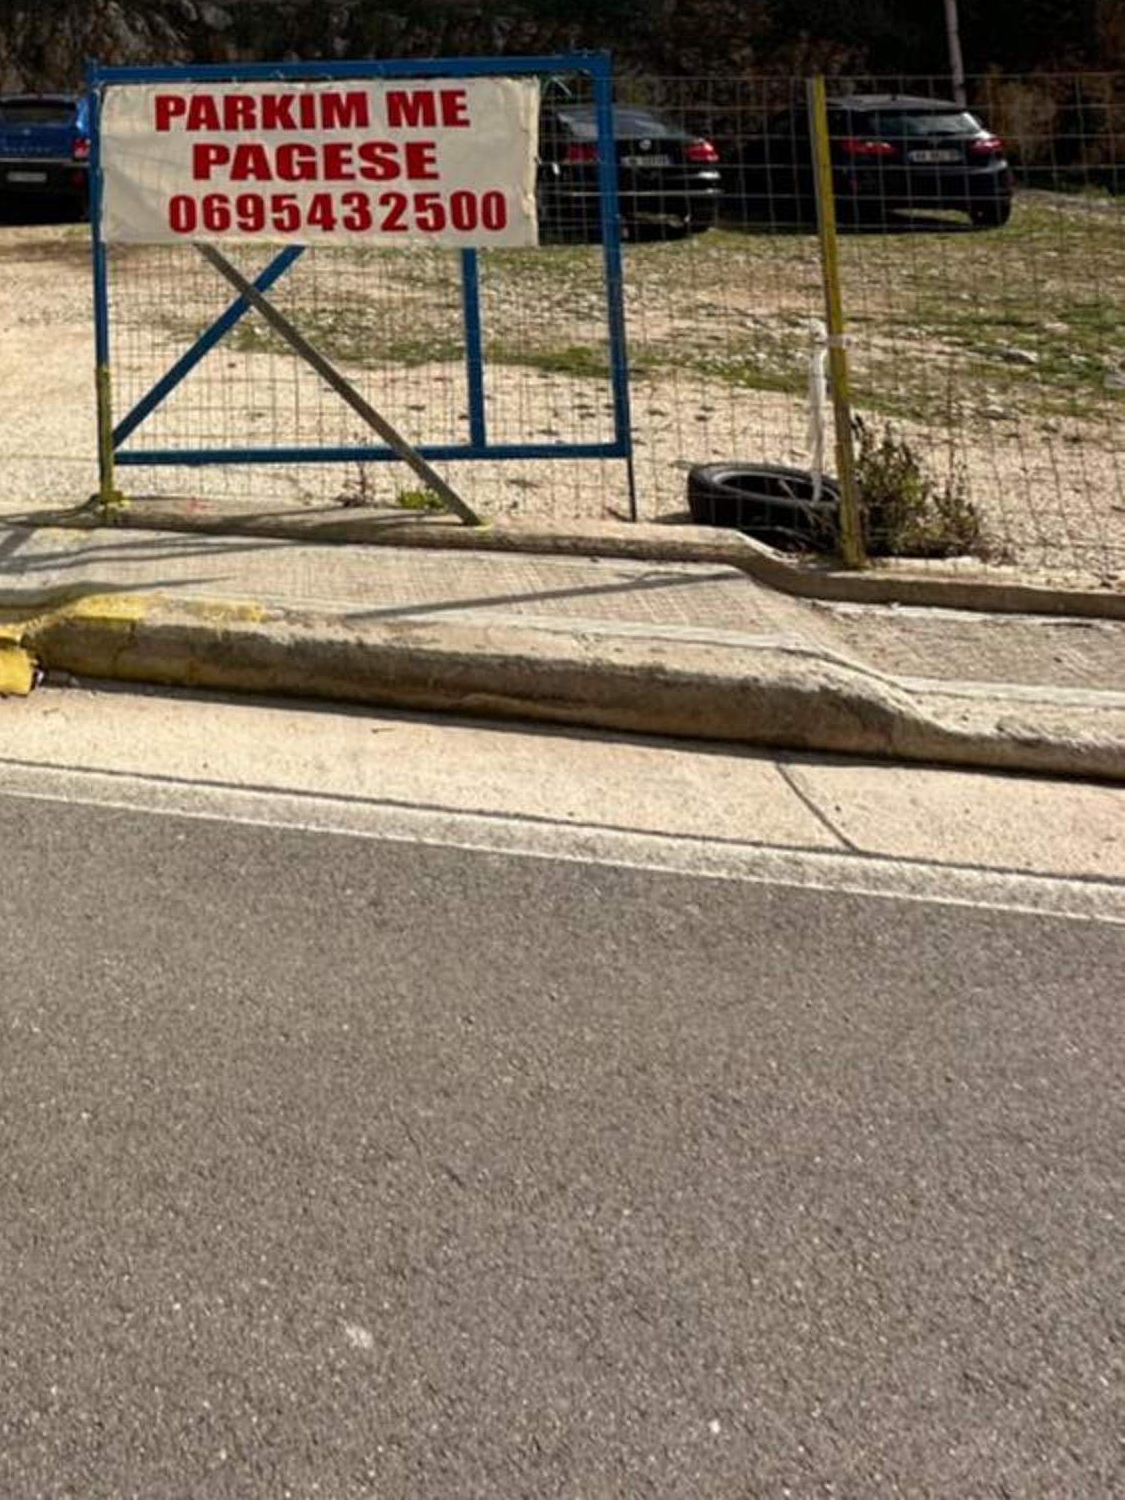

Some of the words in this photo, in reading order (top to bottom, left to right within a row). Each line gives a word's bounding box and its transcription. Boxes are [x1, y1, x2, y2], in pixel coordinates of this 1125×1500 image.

[154, 92, 370, 133] PARKIM
[385, 89, 471, 130] ME
[191, 140, 440, 183] PAGESE
[168, 190, 508, 235] 0695432500
